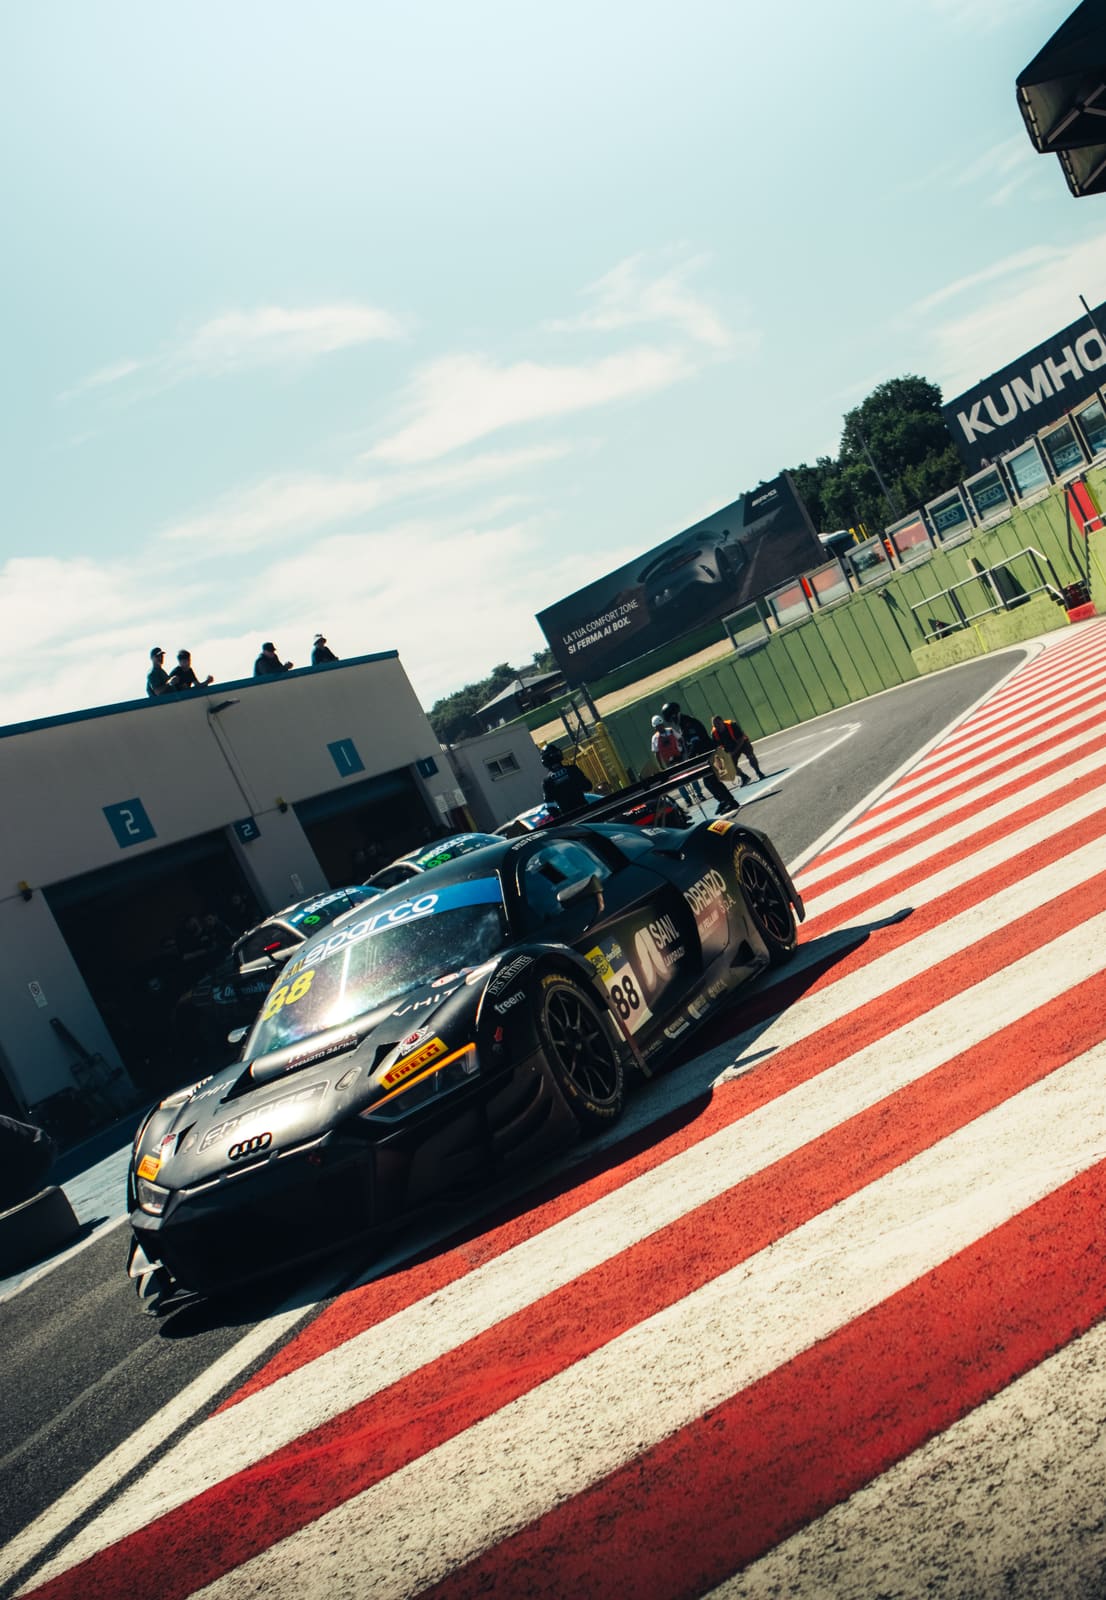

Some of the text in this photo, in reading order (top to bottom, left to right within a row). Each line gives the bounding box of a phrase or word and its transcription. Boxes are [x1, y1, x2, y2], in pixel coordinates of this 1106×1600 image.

[956, 328, 1106, 444] KUMHO
[562, 598, 639, 645] LA TUA COMFORT ZONE
[568, 616, 632, 655] SI FERMA AI BOX.
[119, 809, 141, 835] 2
[241, 822, 256, 837] 2
[303, 914, 321, 925] 9
[303, 893, 439, 967] sparco
[262, 969, 316, 1021] 88
[494, 989, 527, 1015] freem
[610, 975, 640, 1020] 88
[383, 1042, 441, 1084] PIRELLI
